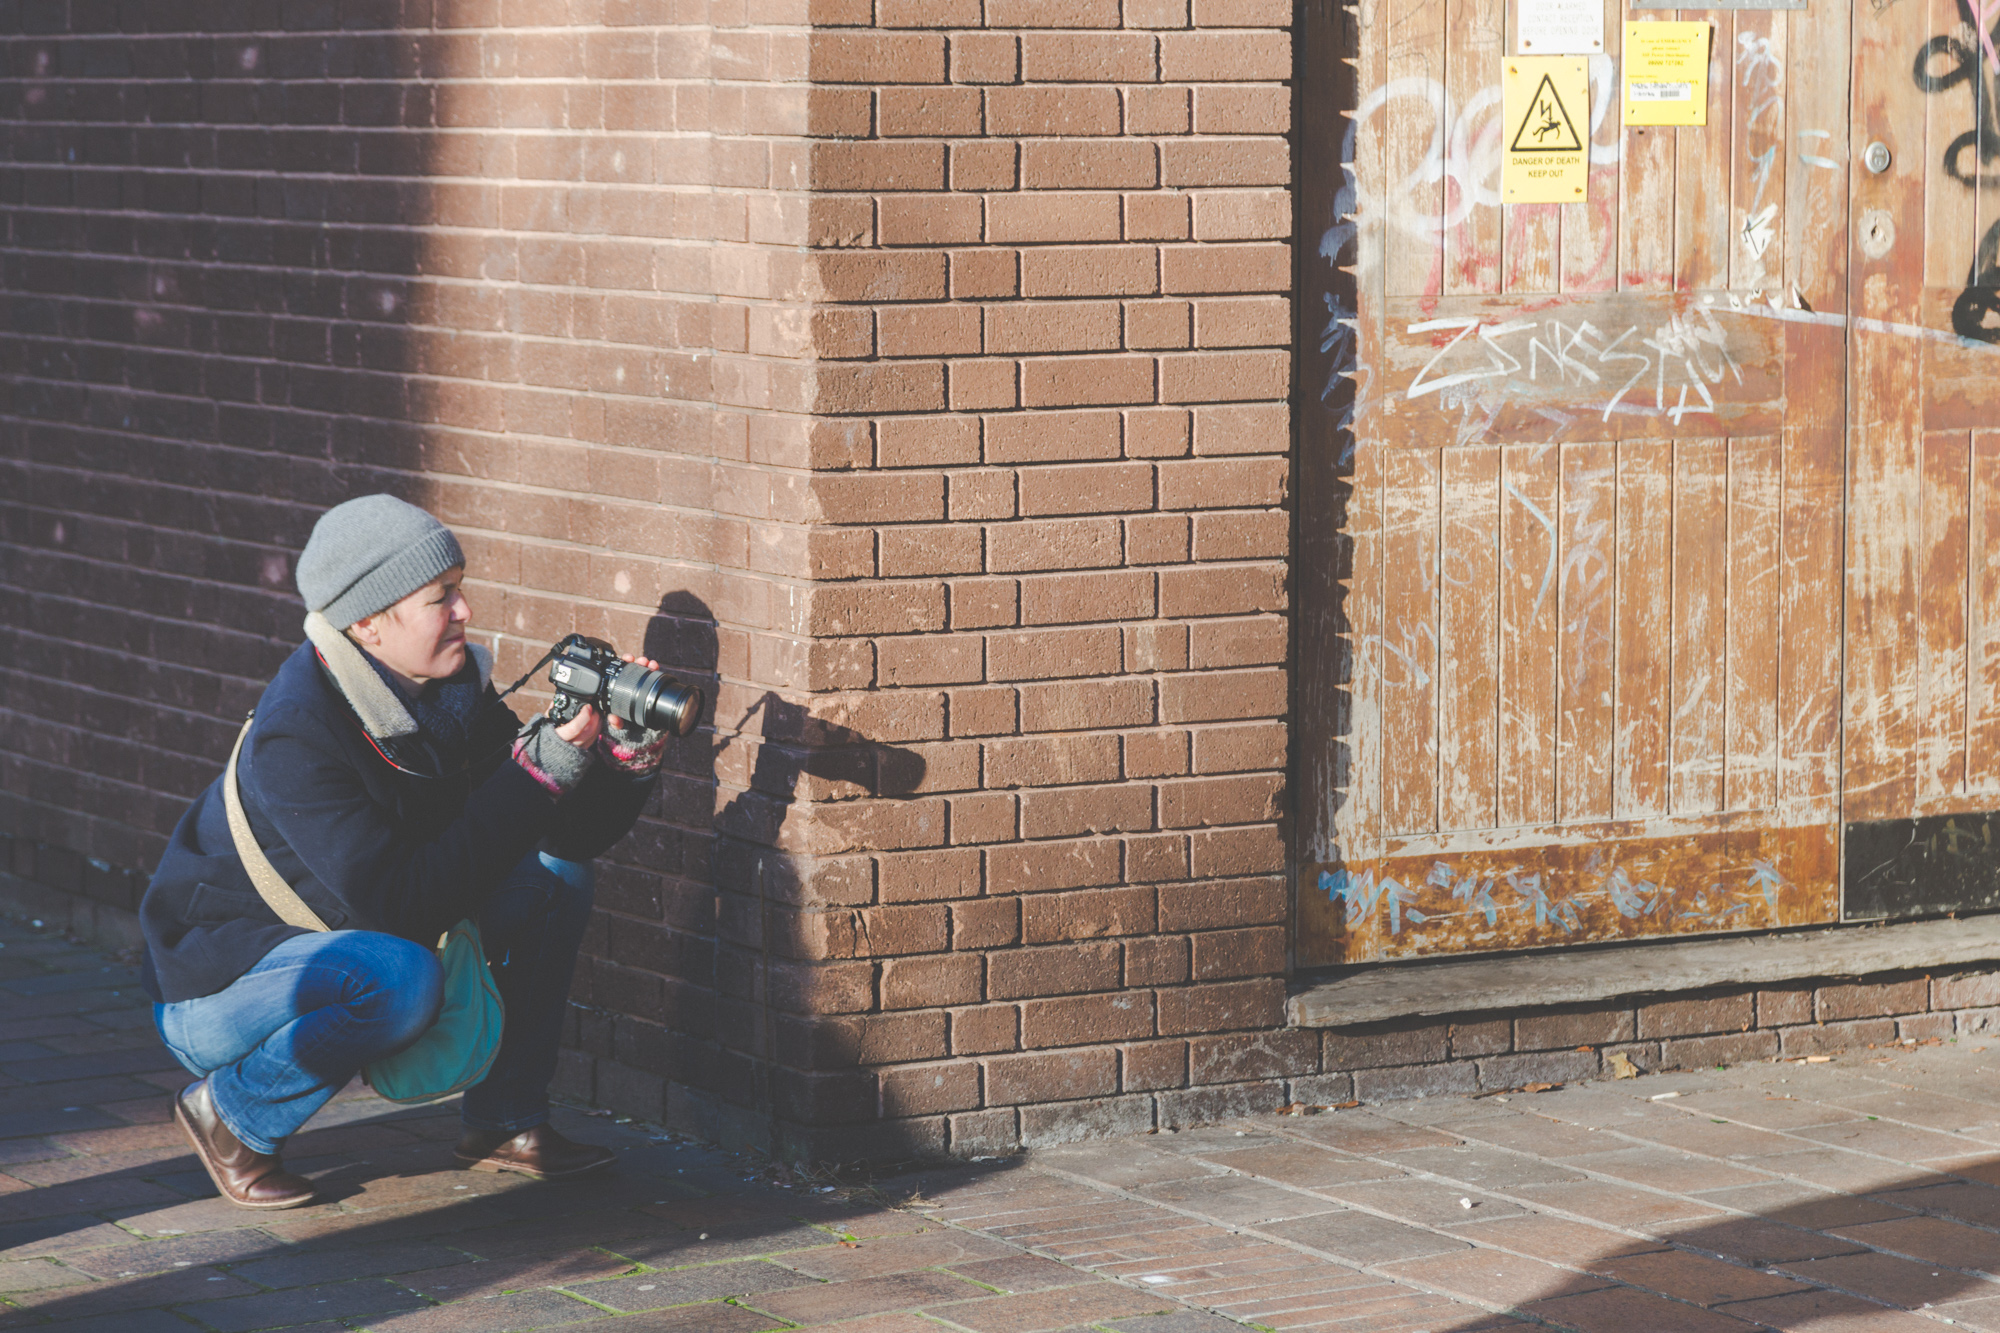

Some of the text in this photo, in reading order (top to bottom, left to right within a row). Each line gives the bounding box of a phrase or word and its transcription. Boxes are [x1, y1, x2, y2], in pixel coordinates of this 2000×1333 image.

[1522, 25, 1599, 35] BEFORE OPENING DOOR
[1512, 156, 1580, 166] DANGER OF DEATH
[1528, 169, 1564, 178] KEEP OUT
